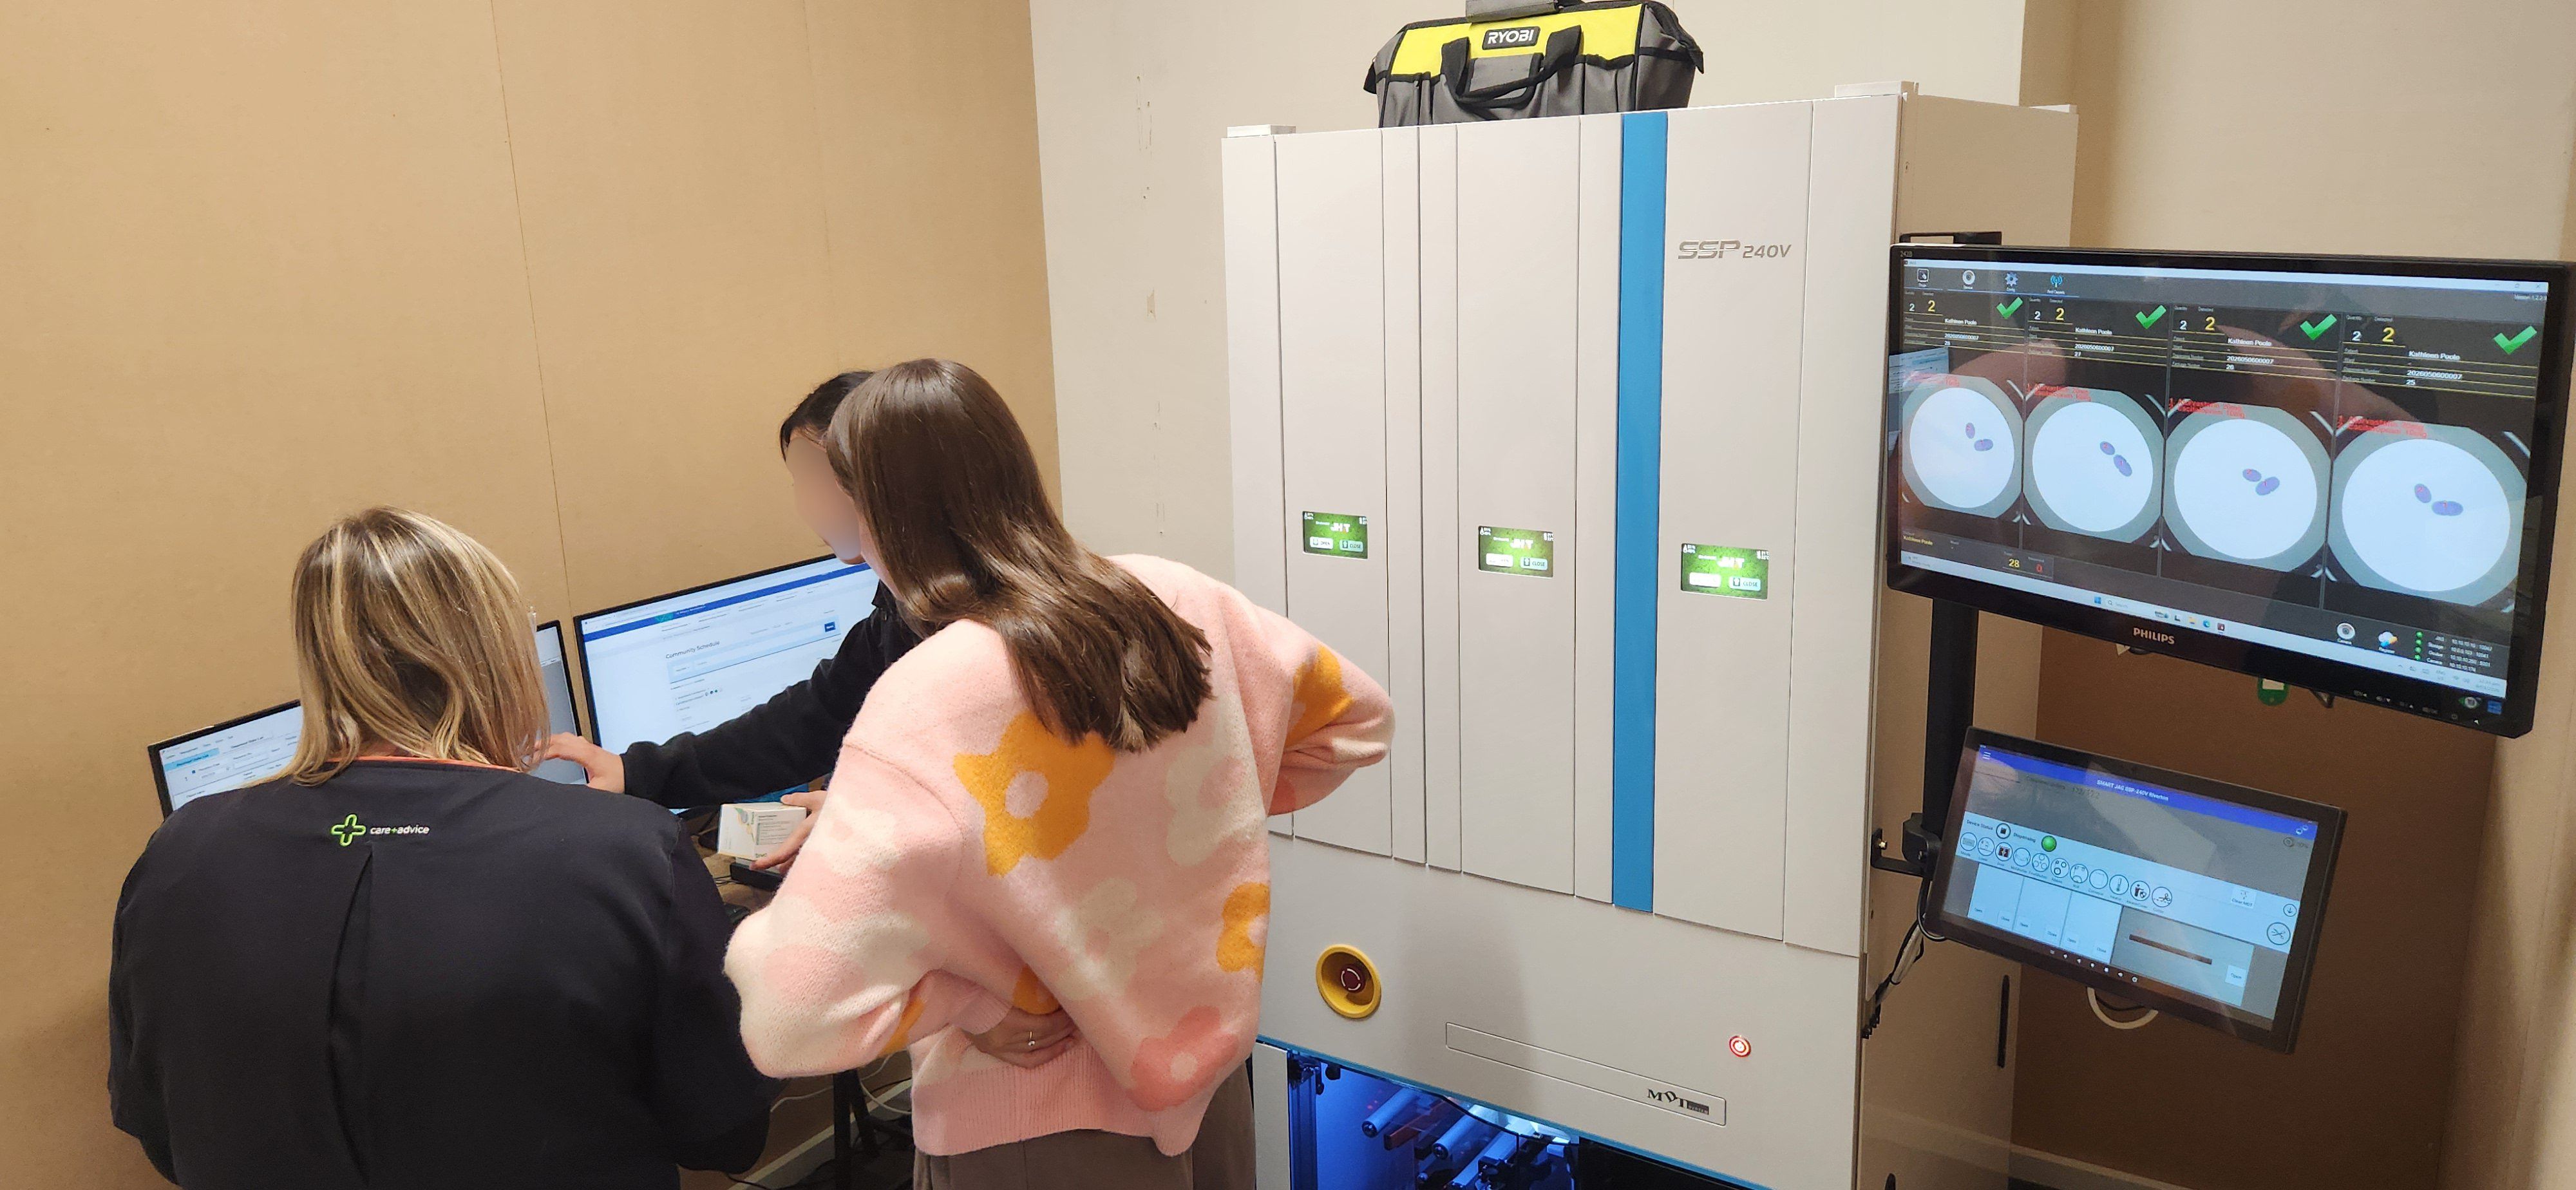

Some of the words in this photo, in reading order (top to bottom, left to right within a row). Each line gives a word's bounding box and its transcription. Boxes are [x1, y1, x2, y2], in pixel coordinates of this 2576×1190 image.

[1488, 30, 1534, 44] RYOBI
[1678, 240, 1741, 260] SSP
[1743, 244, 1792, 259] 240V
[1909, 303, 1915, 312] 2
[1927, 299, 1935, 312] 2
[2034, 310, 2041, 320] 2
[2055, 307, 2065, 321] 2
[2179, 320, 2188, 330] 2
[2204, 316, 2216, 331] 2
[2228, 337, 2253, 346] Kathleen
[2352, 330, 2362, 341] 2
[2382, 326, 2396, 343] 2
[2409, 350, 2439, 359] Kathleen
[2439, 353, 2461, 361] Poole
[2008, 558, 2020, 568] 28
[2133, 627, 2175, 645] PHILIPS
[665, 648, 696, 659] Community
[696, 640, 720, 652] Schedule
[2097, 779, 2114, 788] SMART
[370, 824, 430, 835] care+advice
